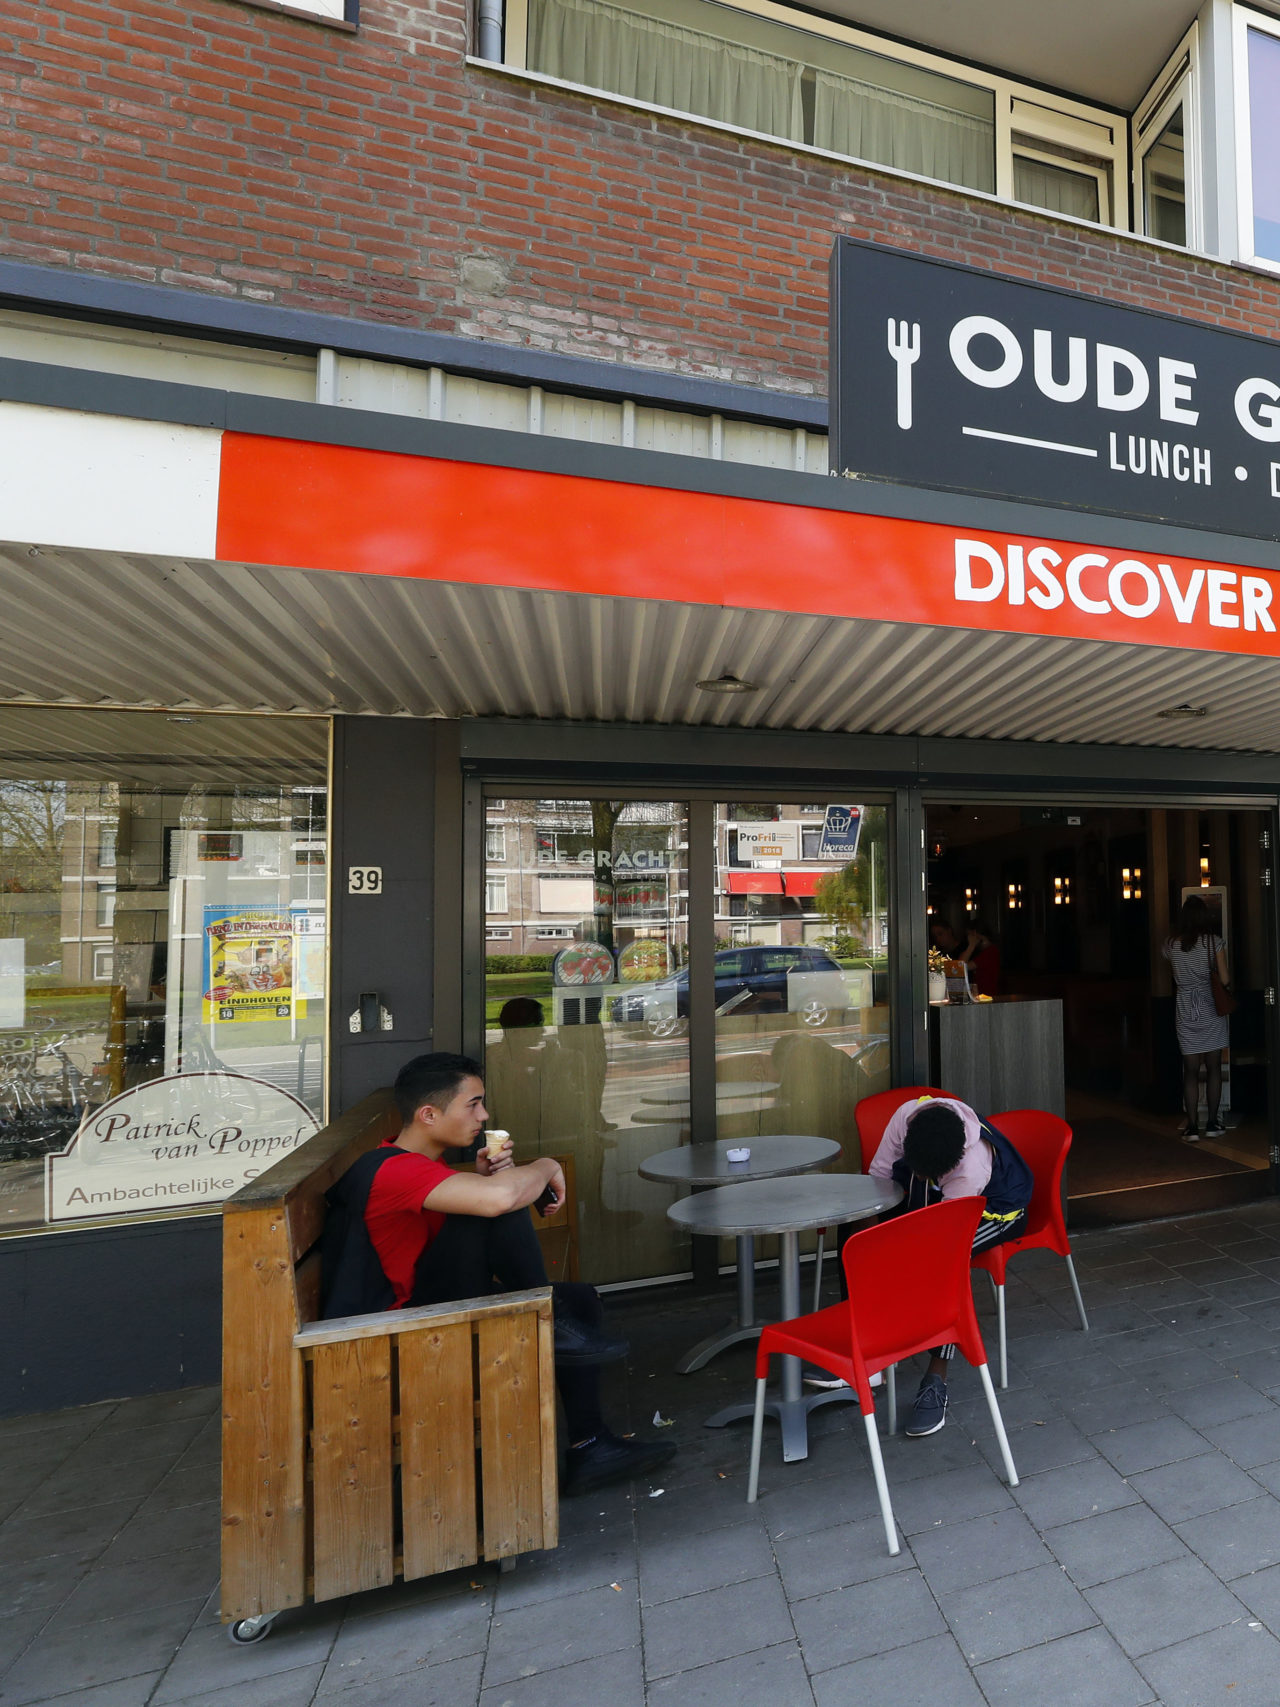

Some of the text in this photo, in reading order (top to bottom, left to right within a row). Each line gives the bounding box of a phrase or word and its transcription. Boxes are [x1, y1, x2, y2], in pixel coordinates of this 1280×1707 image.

[949, 316, 1201, 426] OUDE
[1109, 431, 1212, 486] LUNCH
[954, 538, 1276, 633] DISCOVER
[577, 849, 678, 868] GRACHT
[823, 843, 854, 852] Horeca
[351, 870, 380, 891] 39
[220, 996, 290, 1004] EINDHOVEN
[95, 1112, 206, 1144] Patrick
[151, 1126, 305, 1161] van Poppel
[65, 1174, 235, 1206] Ambachtelijke
